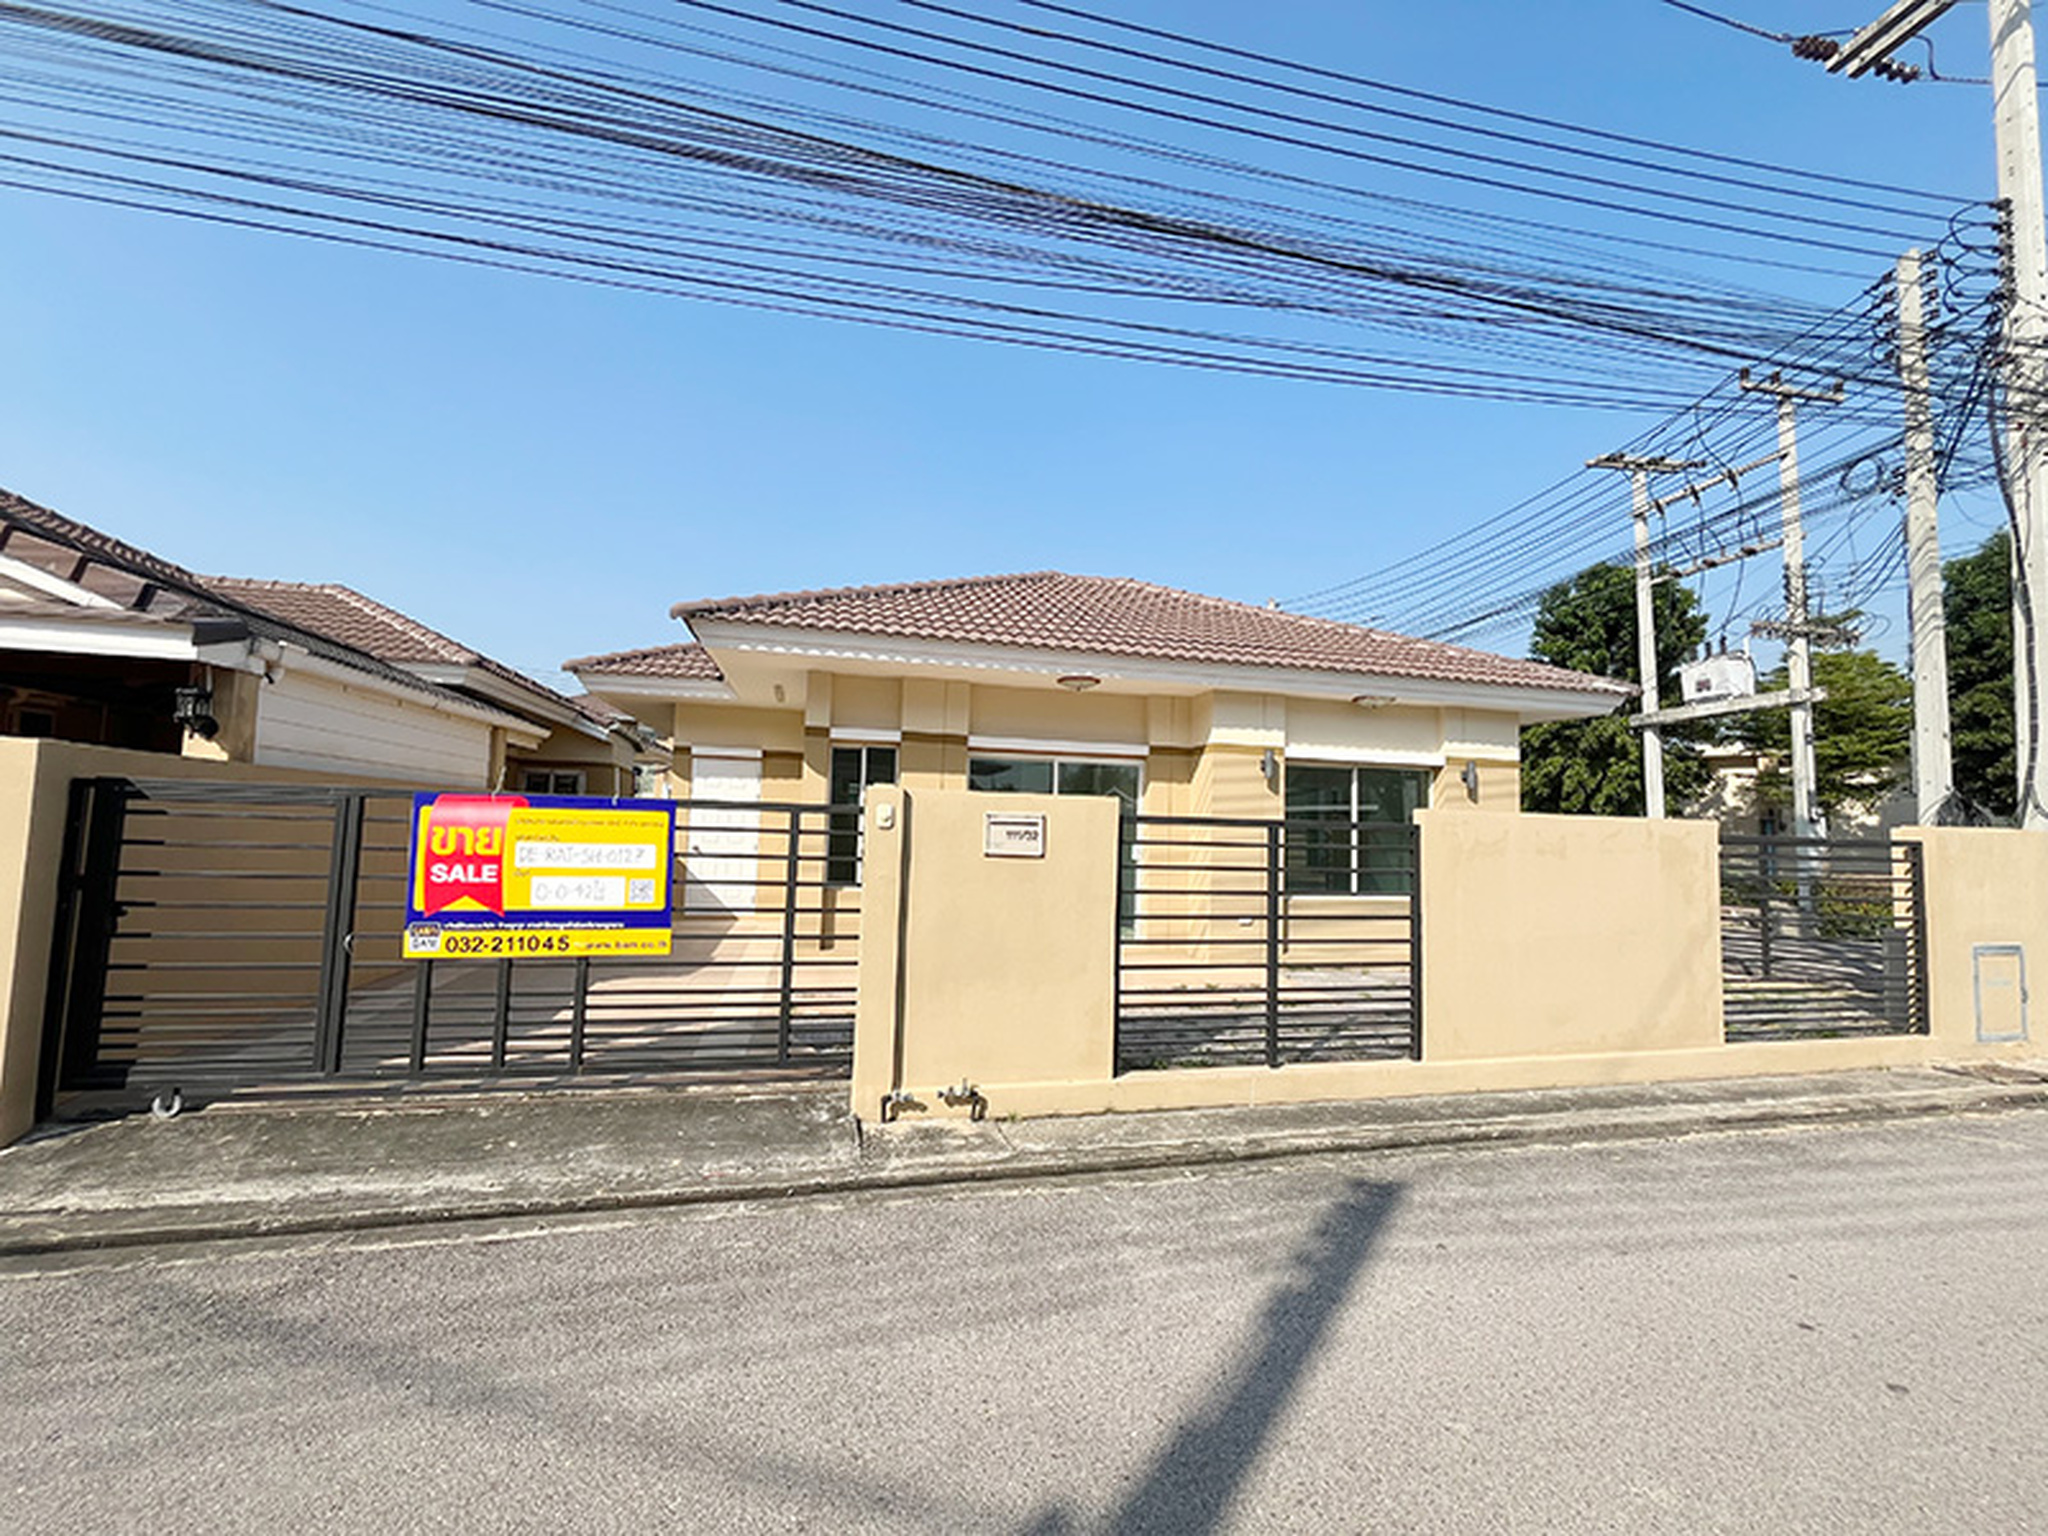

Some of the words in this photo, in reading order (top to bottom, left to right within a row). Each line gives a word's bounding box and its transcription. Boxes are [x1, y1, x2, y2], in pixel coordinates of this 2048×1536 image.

[431, 825, 502, 856] ขาย
[430, 862, 499, 883] SALE
[445, 935, 570, 952] 032-211045
